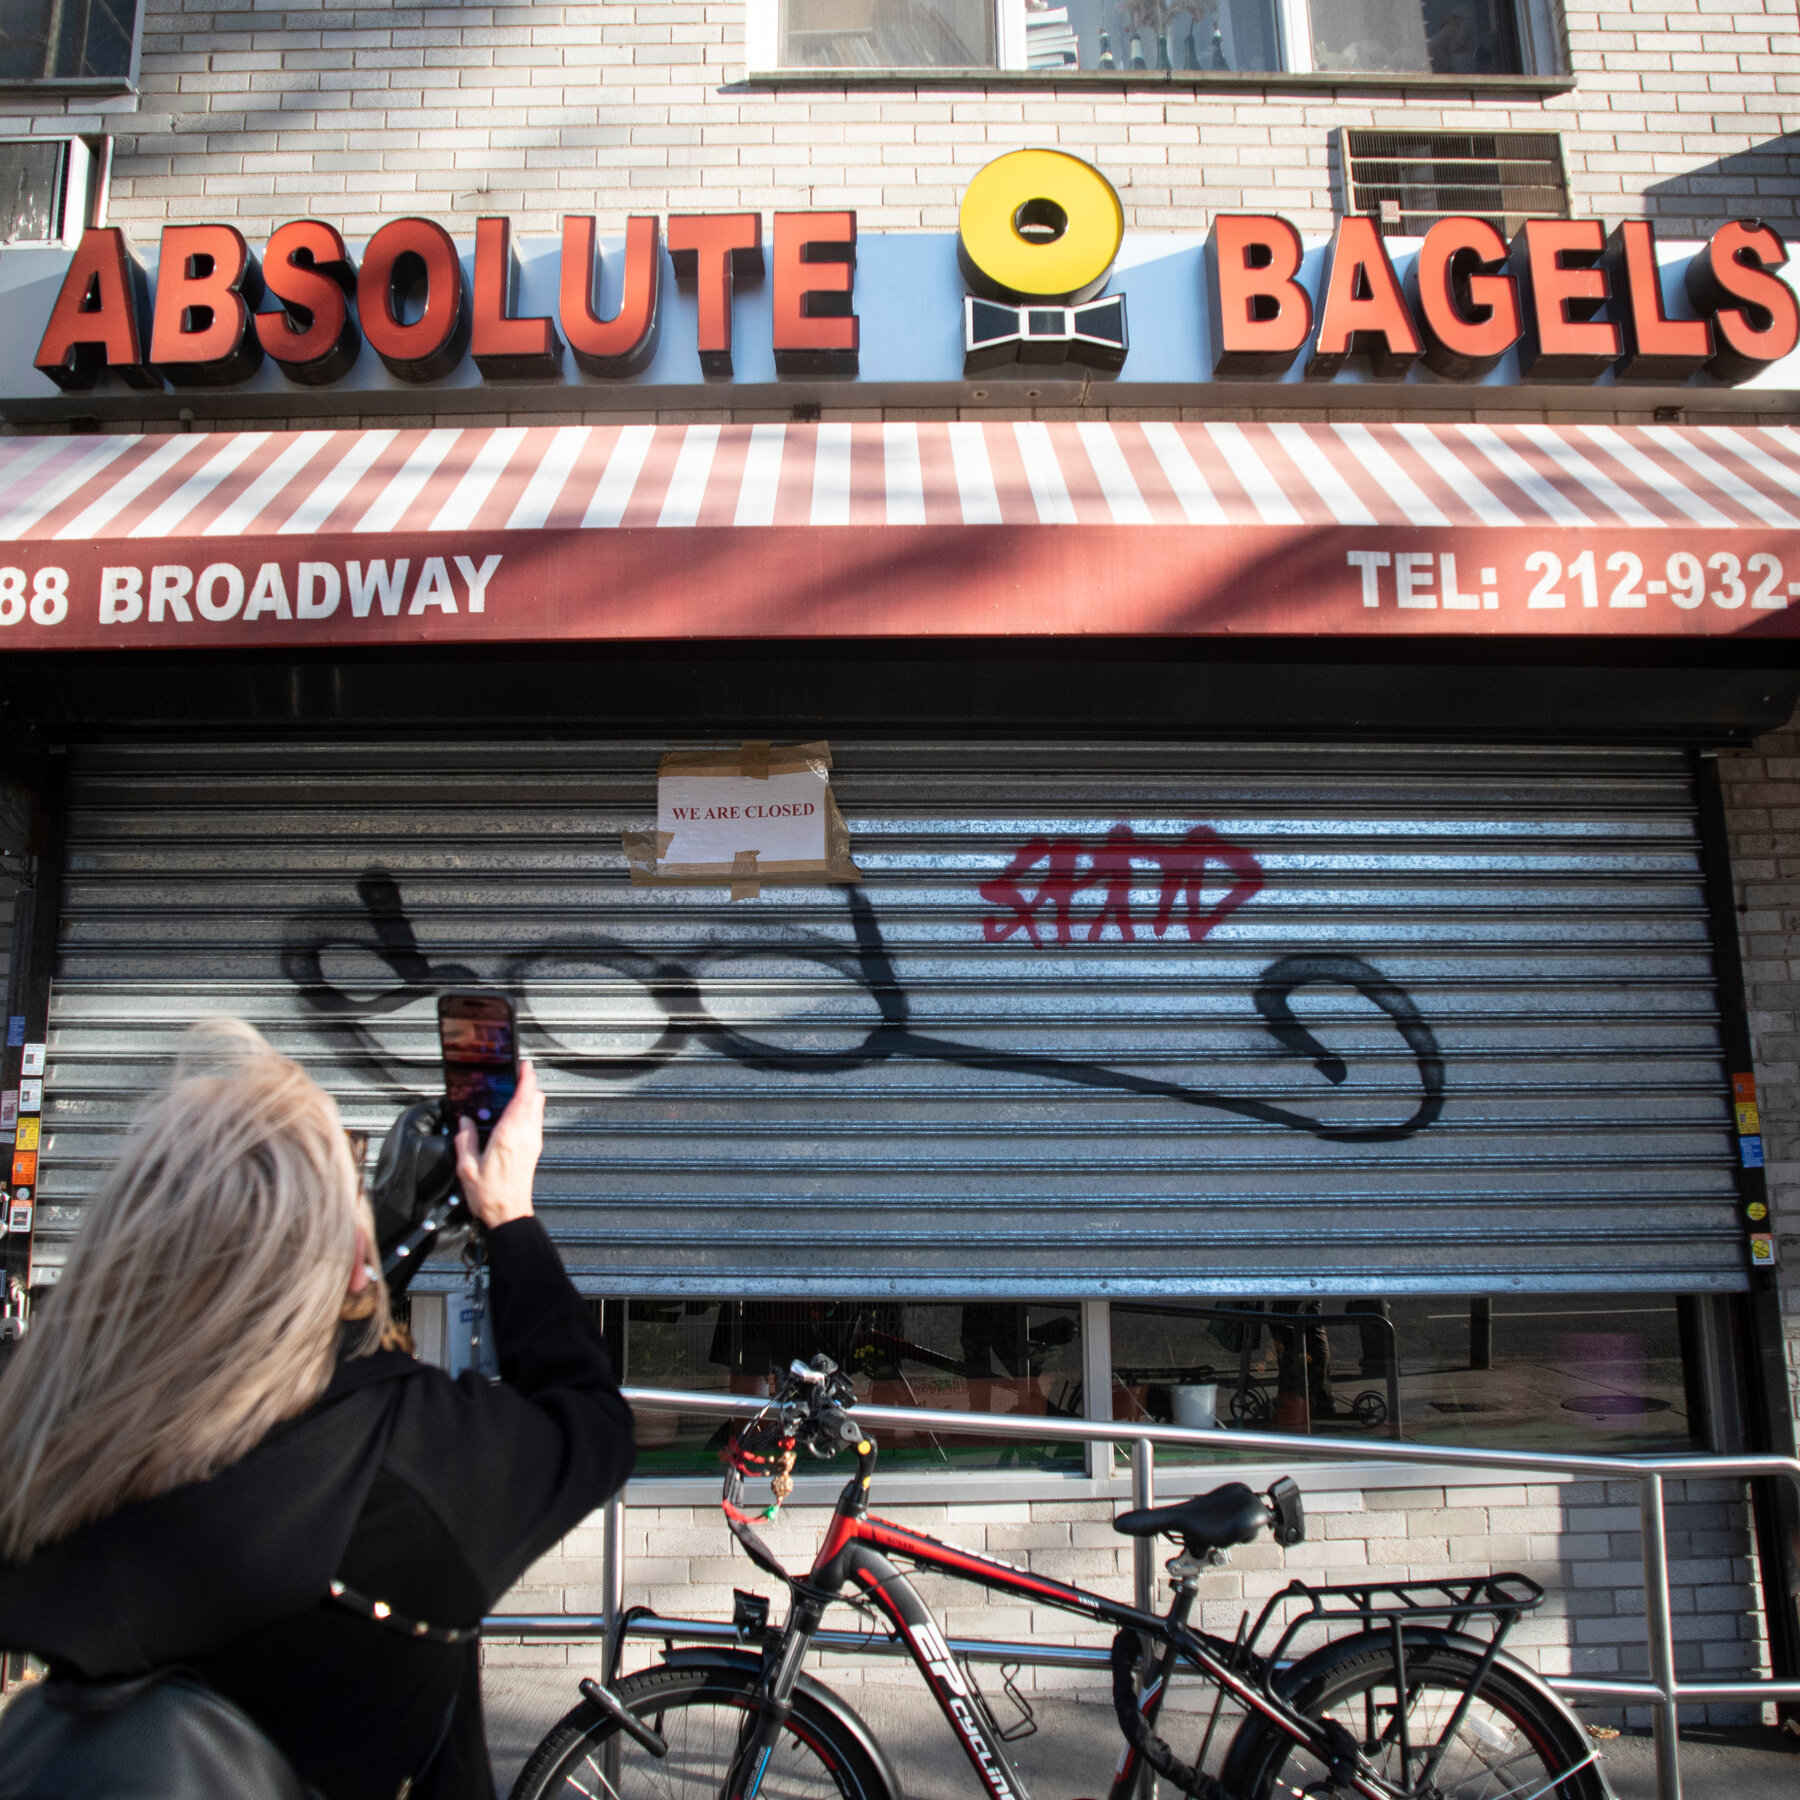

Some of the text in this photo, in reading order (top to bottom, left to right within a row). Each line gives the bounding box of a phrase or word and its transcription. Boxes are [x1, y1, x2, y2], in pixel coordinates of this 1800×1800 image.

[34, 210, 1800, 378] ABSOLUTE BAGELS
[98, 554, 503, 625] BROADWAY
[1346, 550, 1500, 610] TEL:
[672, 802, 815, 821] WE ARE CLOSED
